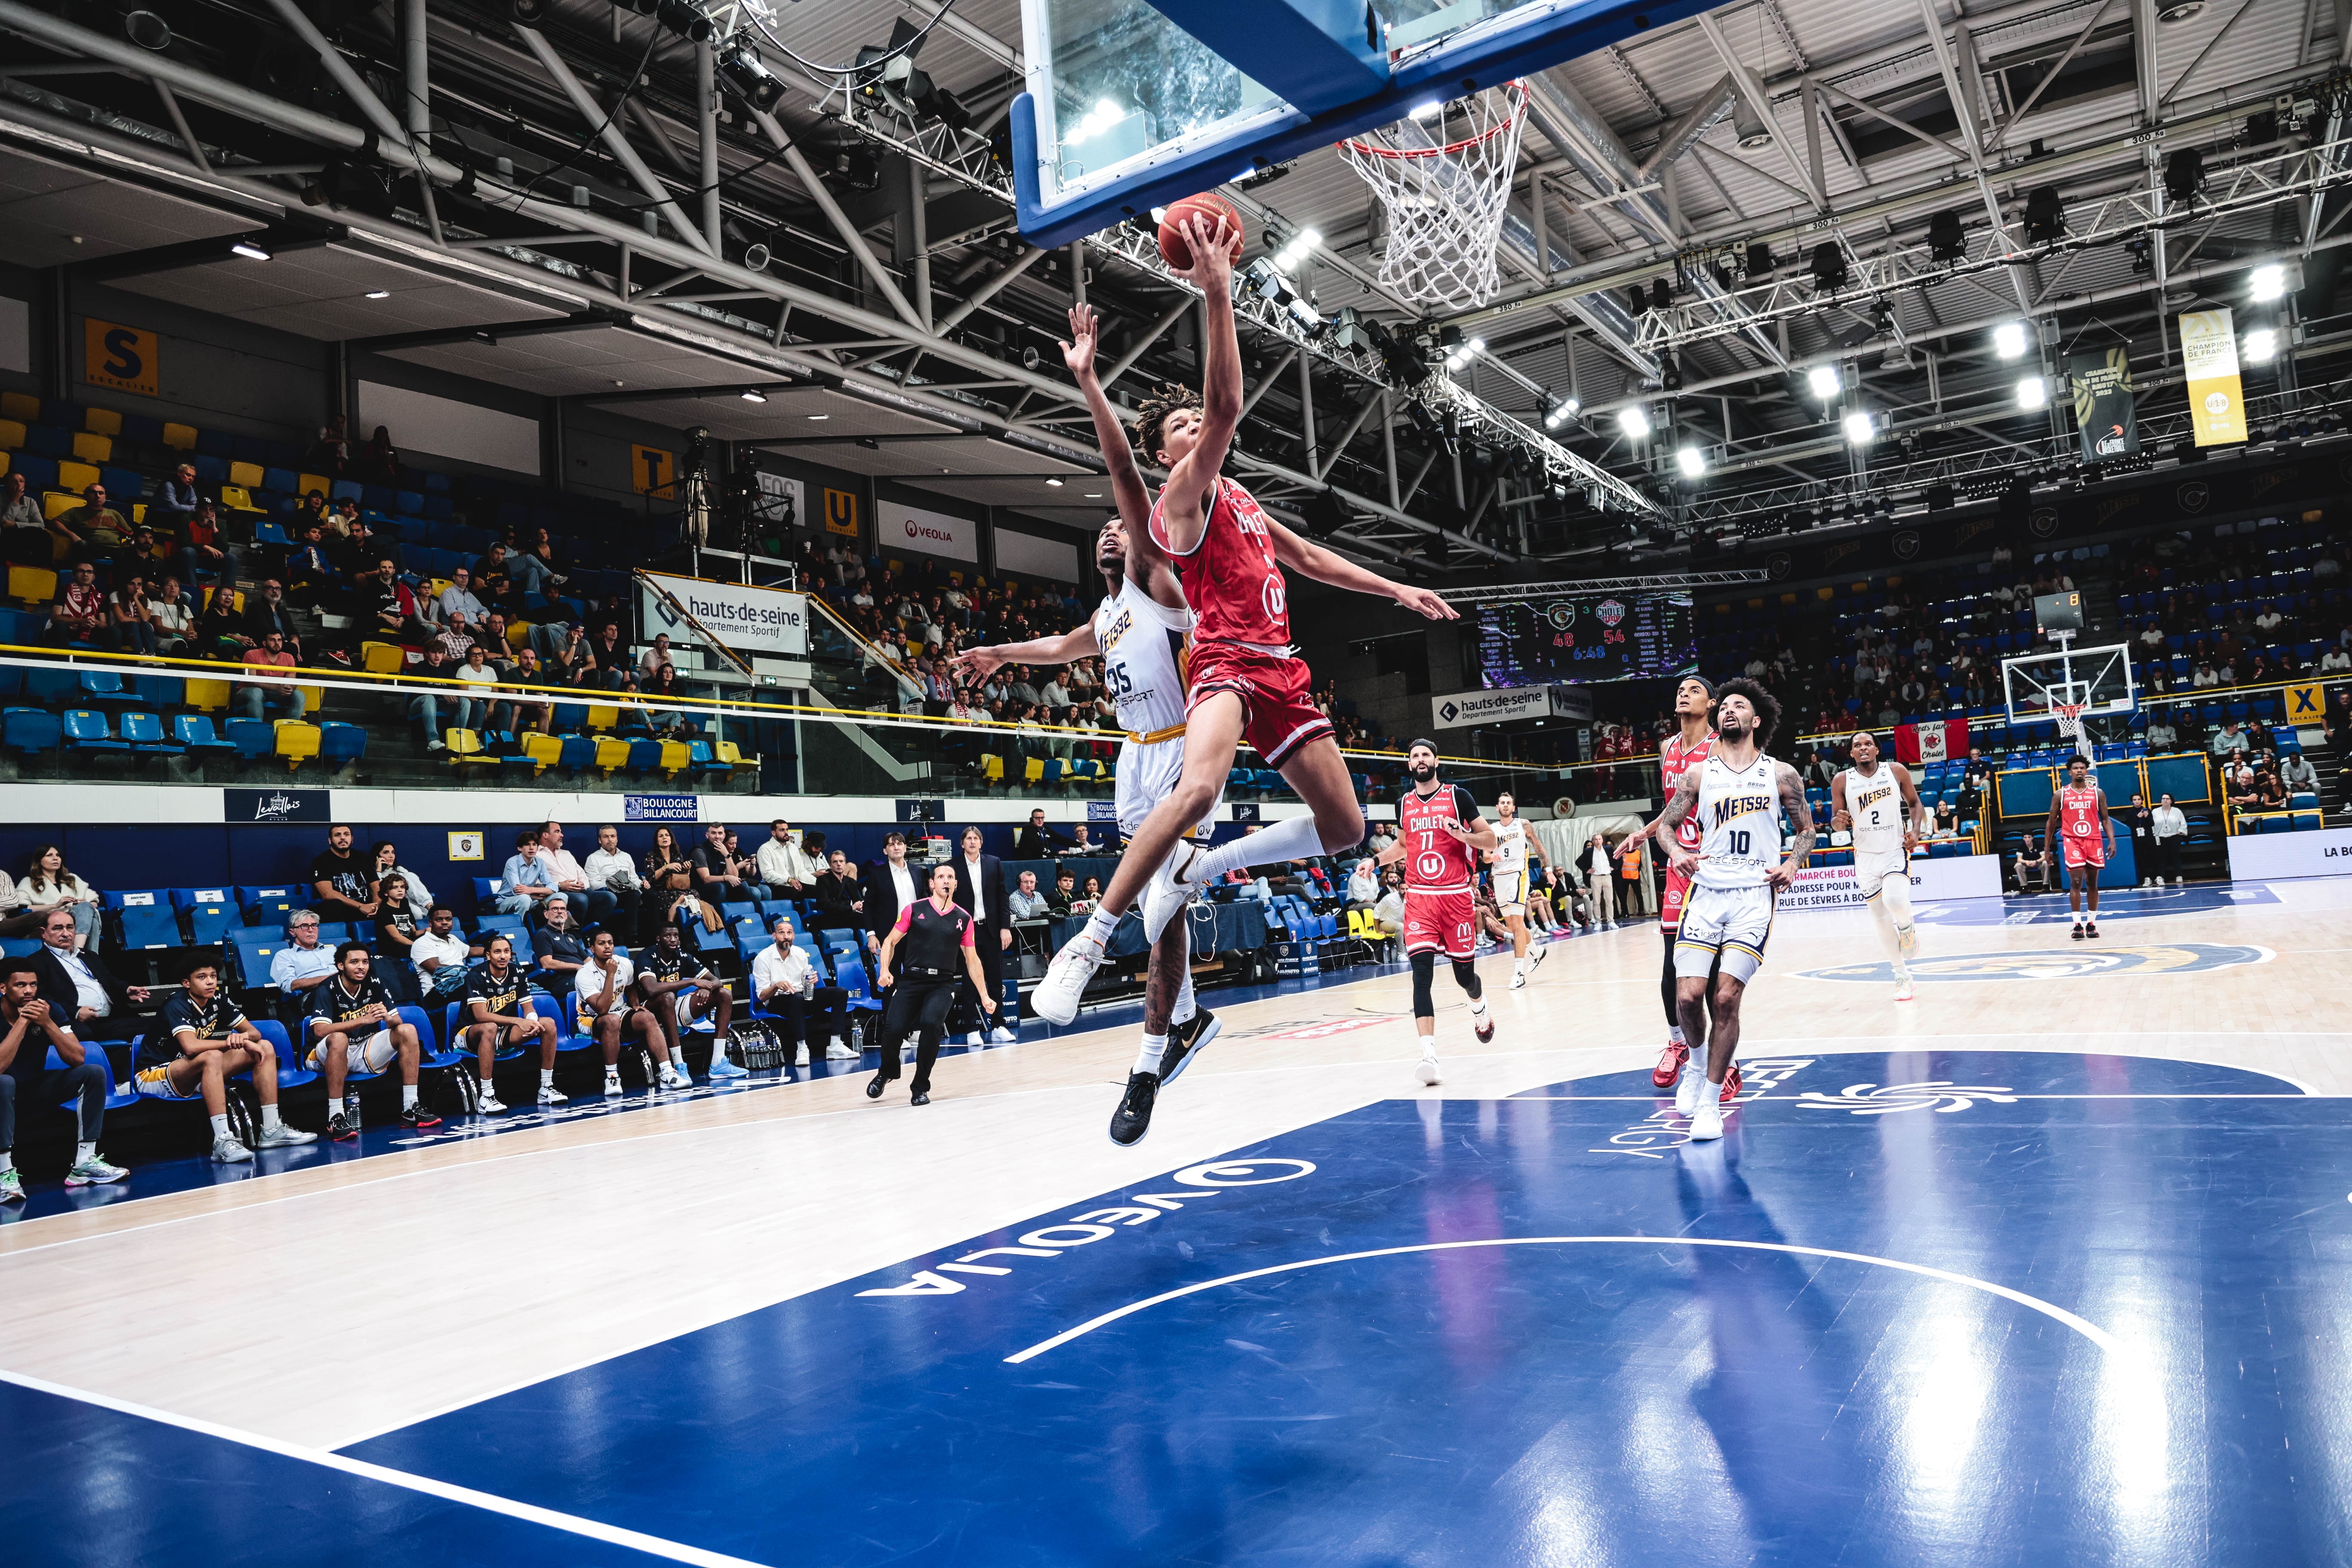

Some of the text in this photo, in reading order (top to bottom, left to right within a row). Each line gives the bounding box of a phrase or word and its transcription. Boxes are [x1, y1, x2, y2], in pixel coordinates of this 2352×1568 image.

[2132, 134, 2151, 144] 300
[1813, 220, 1828, 229] 300
[2187, 341, 2231, 352] CHAMPION
[2202, 347, 2232, 355] FRANCE
[103, 329, 142, 380] S
[641, 450, 663, 489] T
[830, 492, 852, 527] U
[919, 527, 952, 542] VEOLIA
[1270, 588, 1284, 615] U
[2070, 593, 2079, 606] 8
[1583, 606, 1590, 614] 3
[1596, 606, 1625, 617] CHOLET
[698, 617, 780, 638] épartement Sportif
[1553, 633, 1574, 646] 48
[1604, 629, 1625, 643] 54
[1573, 645, 1605, 660] 6:48
[1622, 653, 1629, 662] 0
[1550, 658, 1555, 667] 1
[1106, 662, 1132, 697] 35
[2294, 688, 2317, 713] X
[1505, 704, 1526, 715] Sportif
[1912, 723, 1950, 733] Reds fans
[1922, 749, 1944, 760] Cholet
[643, 798, 696, 808] BOULOGNE-
[1857, 787, 1891, 812] METS92
[2069, 801, 2092, 810] CHOLET
[255, 796, 300, 819] Levallois
[643, 809, 697, 818] BILLANCOURT
[1714, 797, 1770, 832] METS92
[1871, 811, 1880, 825] 2
[2078, 809, 2085, 820] 2
[1125, 820, 1140, 831] ide
[1410, 814, 1444, 833] CHOLET
[2077, 824, 2088, 833] U
[1420, 831, 1433, 850] 77
[1497, 833, 1518, 848] METS92
[1729, 830, 1750, 854] 10
[1504, 848, 1509, 858] 9
[2324, 847, 2338, 857] LA
[1423, 858, 1438, 873] U
[1788, 884, 1824, 894] ADRESSE
[1827, 881, 1847, 891] POUR
[1779, 897, 1795, 907] RUE
[1798, 897, 1808, 906] DE
[1811, 894, 1841, 905] SÈVRES
[1844, 892, 1850, 903] À
[487, 990, 516, 1014] METS92
[854, 1191, 1221, 1297] VEOLIA
